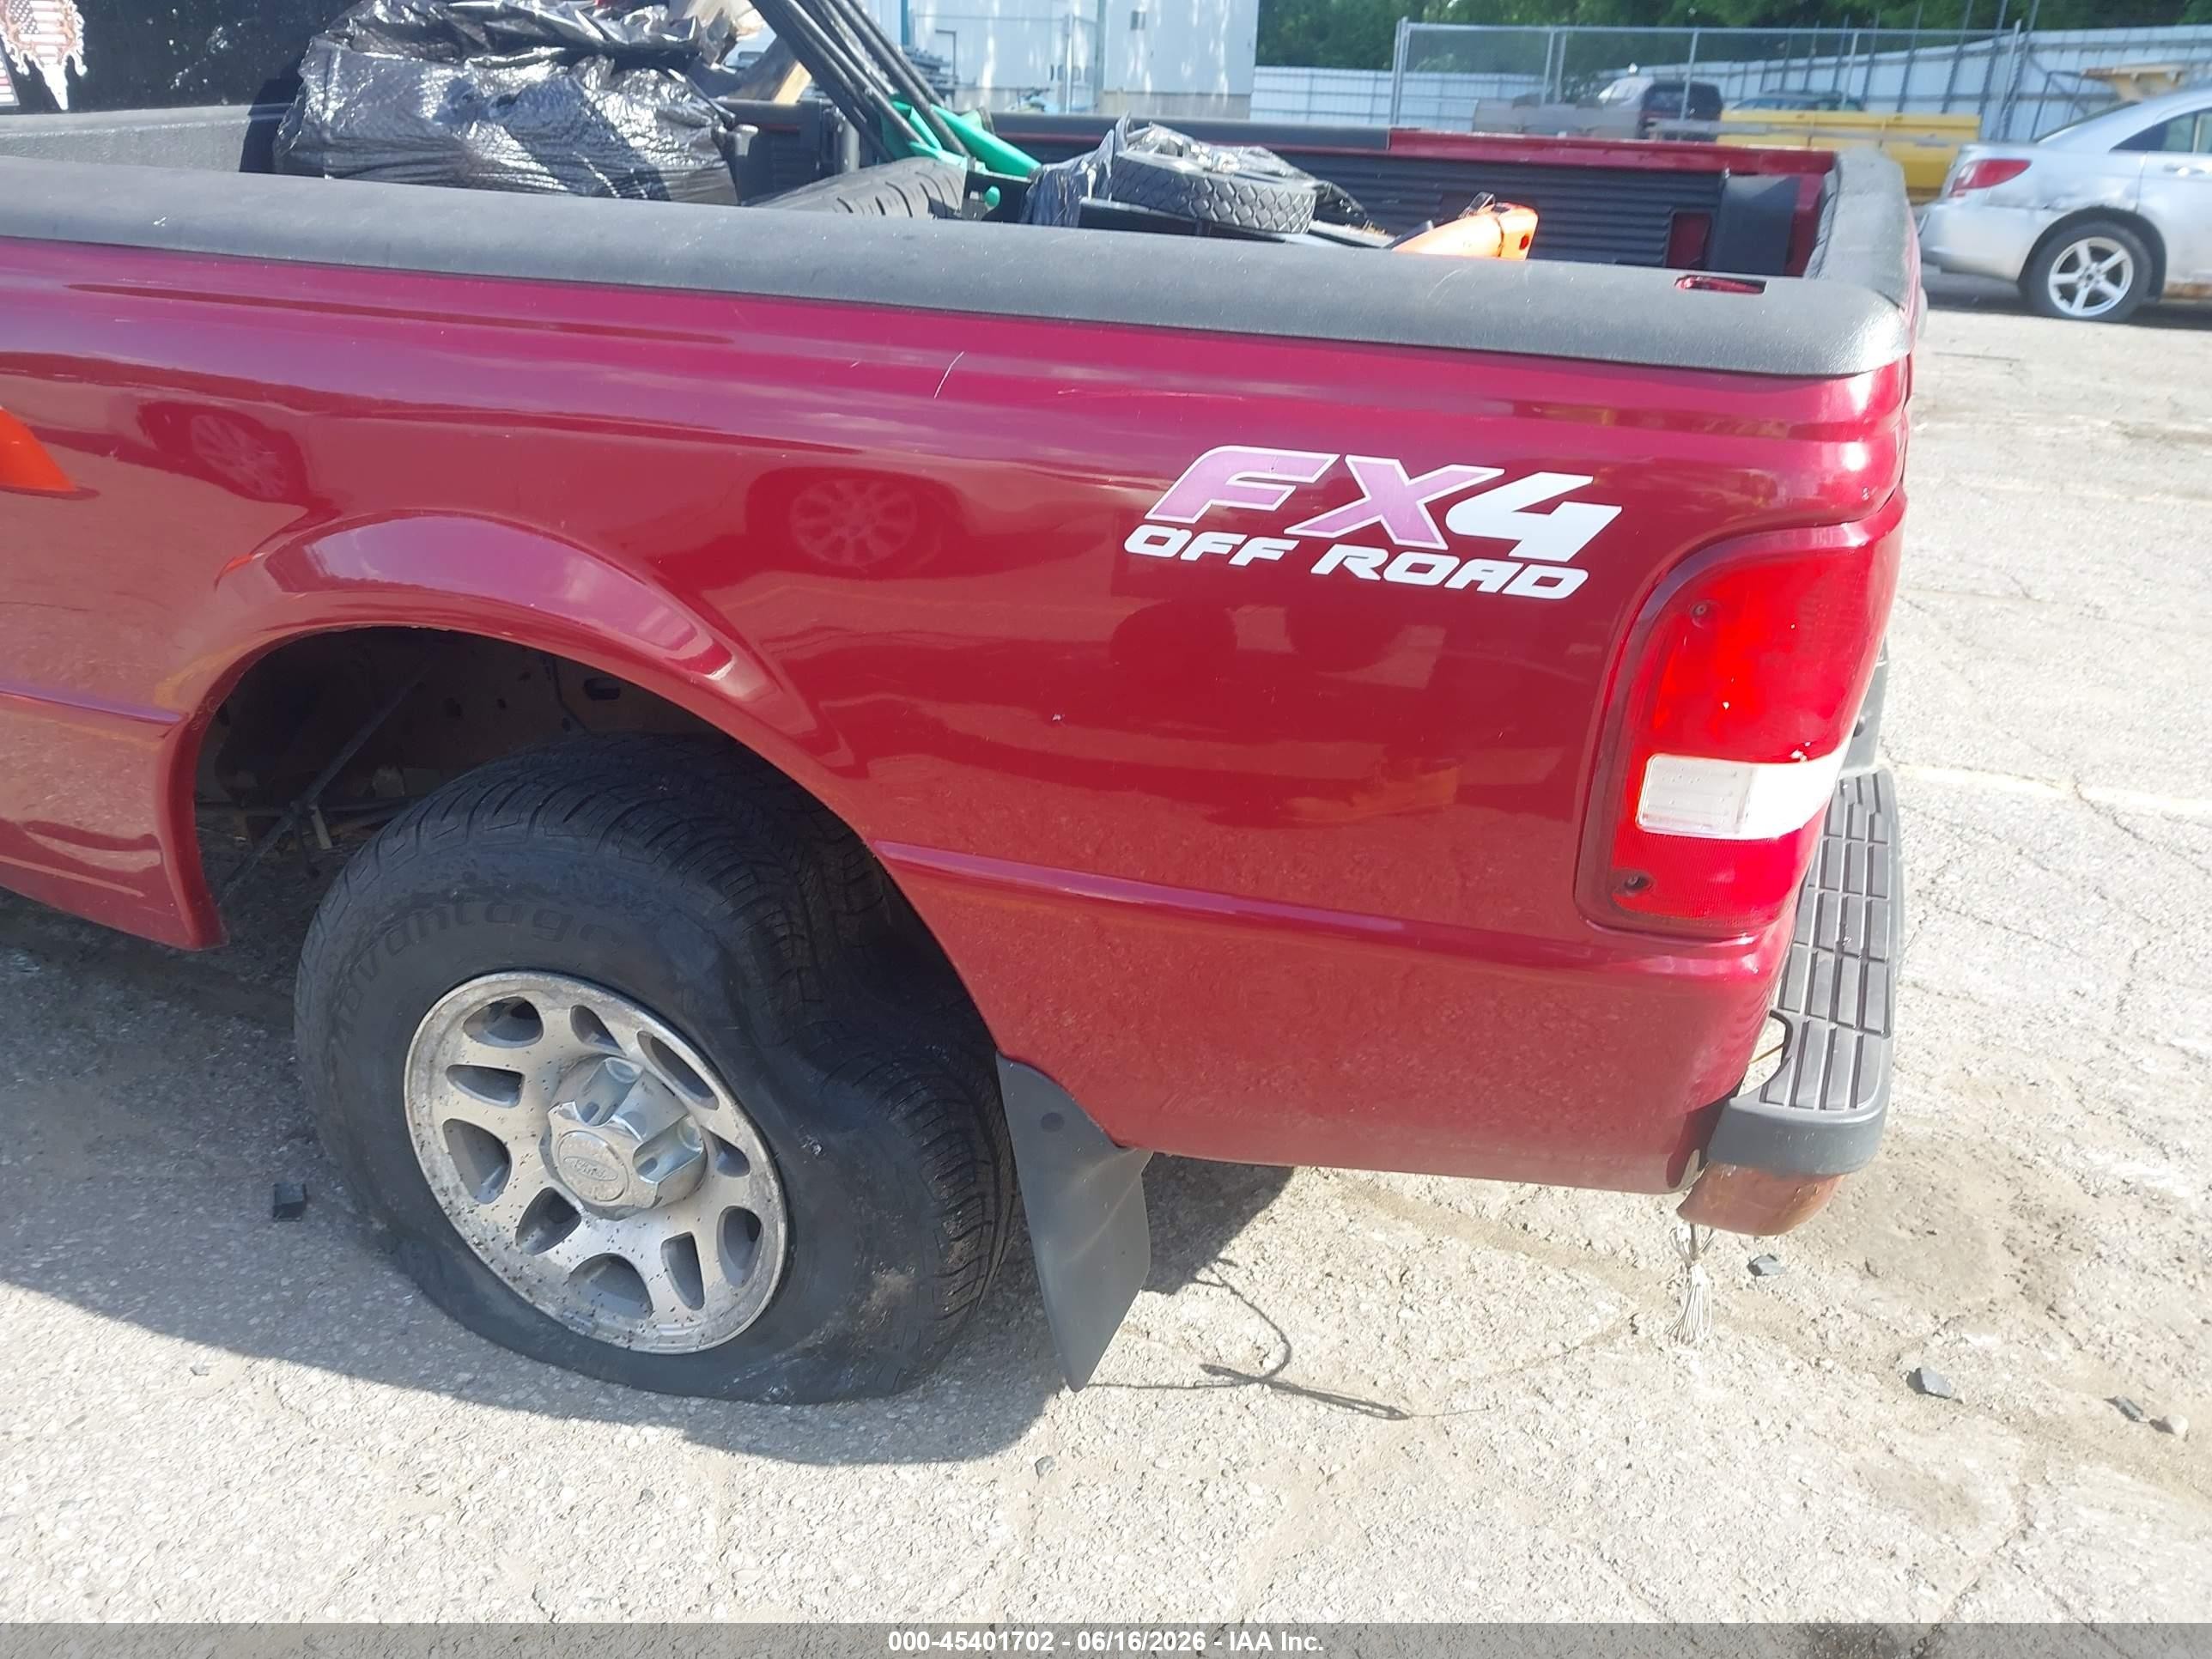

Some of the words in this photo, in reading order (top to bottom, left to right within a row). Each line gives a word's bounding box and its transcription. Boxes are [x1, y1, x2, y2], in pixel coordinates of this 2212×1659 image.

[1145, 445, 1623, 562] FX4
[1124, 523, 1300, 567] OFF
[1310, 543, 1589, 599] ROAD
